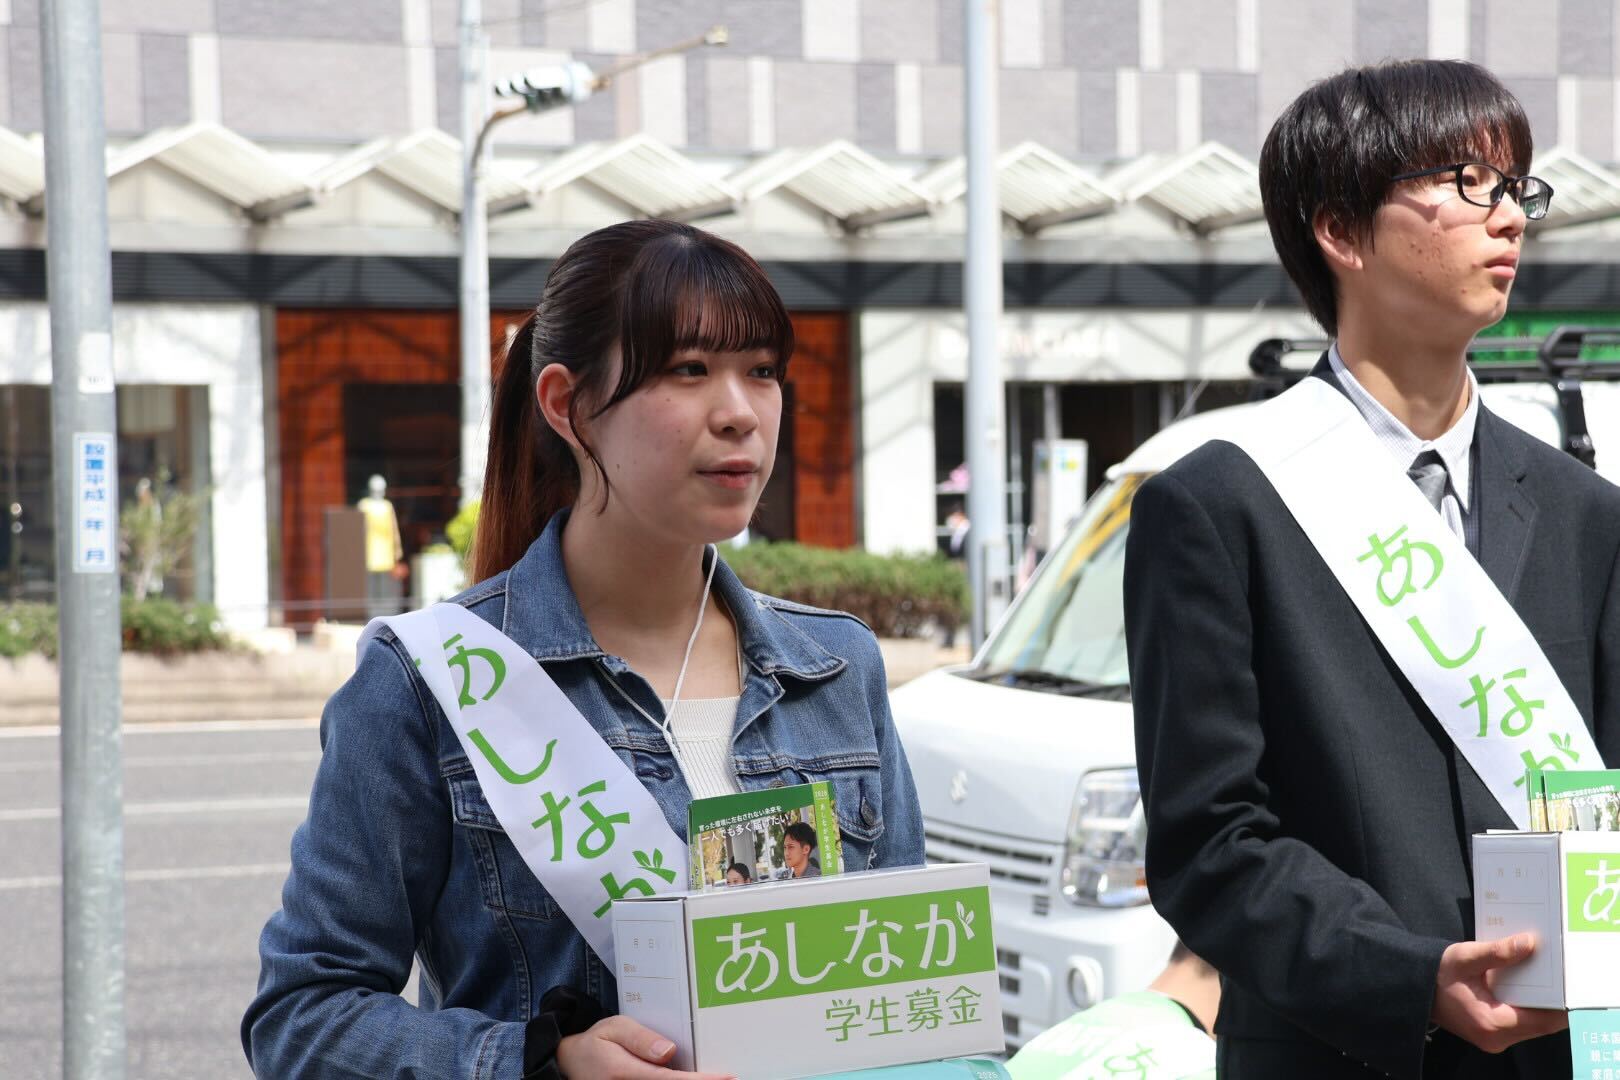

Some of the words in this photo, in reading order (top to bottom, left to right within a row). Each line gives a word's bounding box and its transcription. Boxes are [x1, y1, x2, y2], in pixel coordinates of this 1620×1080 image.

[1356, 524, 1580, 788] あしなが
[701, 813, 790, 841] 一人でも多く届けたい
[715, 901, 976, 994] あしなが
[825, 984, 983, 1043] 学生募金
